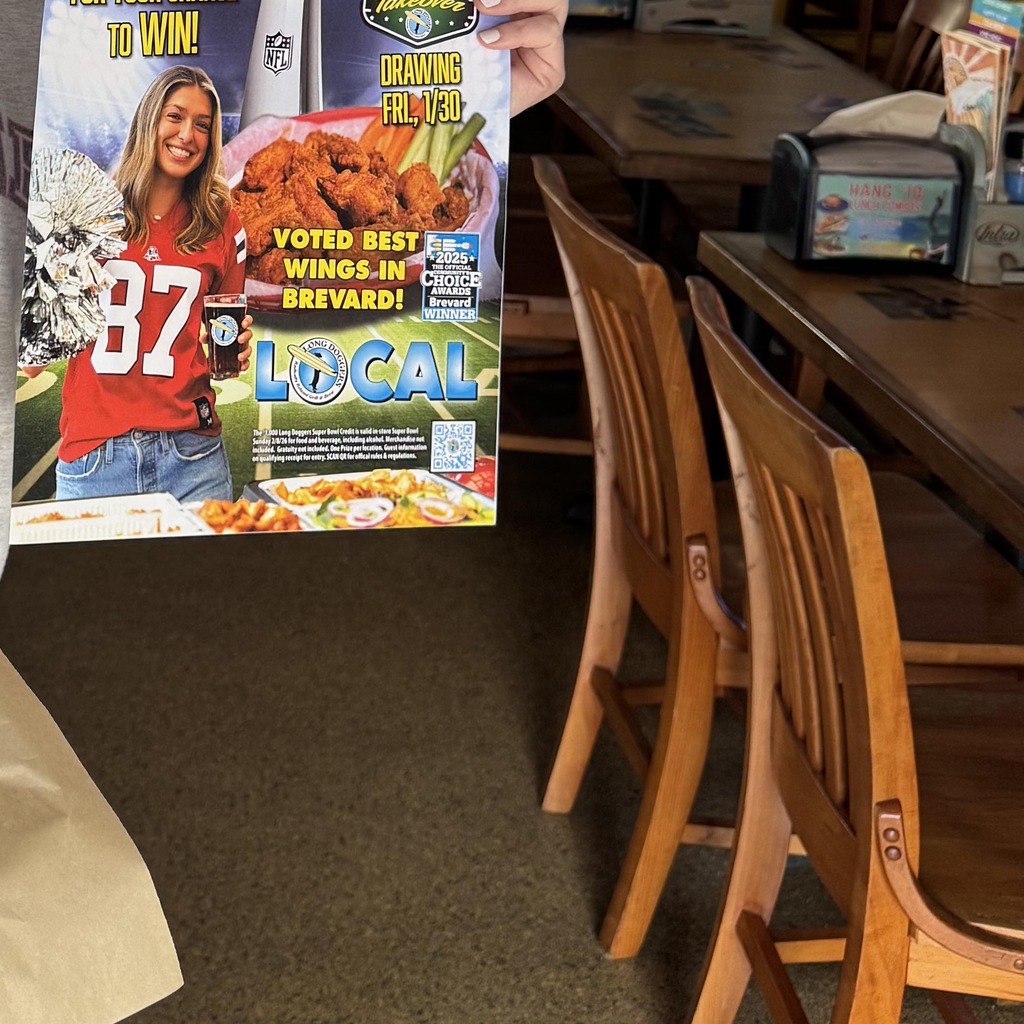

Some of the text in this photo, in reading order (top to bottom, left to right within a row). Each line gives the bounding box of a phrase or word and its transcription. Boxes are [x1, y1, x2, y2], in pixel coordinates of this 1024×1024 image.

[107, 10, 200, 58] TO WIN!
[266, 48, 288, 69] NFL
[380, 52, 461, 87] DRAWING
[382, 89, 461, 127] FRI., 1/30
[850, 184, 892, 199] HANG
[273, 228, 419, 252] VOTED BEST
[436, 252, 468, 264] 2025
[283, 258, 406, 280] WINGS IN
[421, 270, 482, 287] CHOICE
[282, 288, 404, 310] BREVARD!
[430, 287, 472, 295] AWARDS
[429, 297, 471, 307] Brevard
[90, 259, 201, 377] 87
[424, 308, 476, 319] WINNER
[302, 340, 346, 388] LONG DOGGERS
[279, 429, 291, 437] Long
[291, 428, 312, 437] Doggers
[312, 428, 326, 436] Super
[327, 428, 339, 436] Bowl
[392, 427, 406, 435] Super
[342, 436, 365, 444] including
[259, 455, 285, 463] qualifying
[285, 454, 303, 462] receipt
